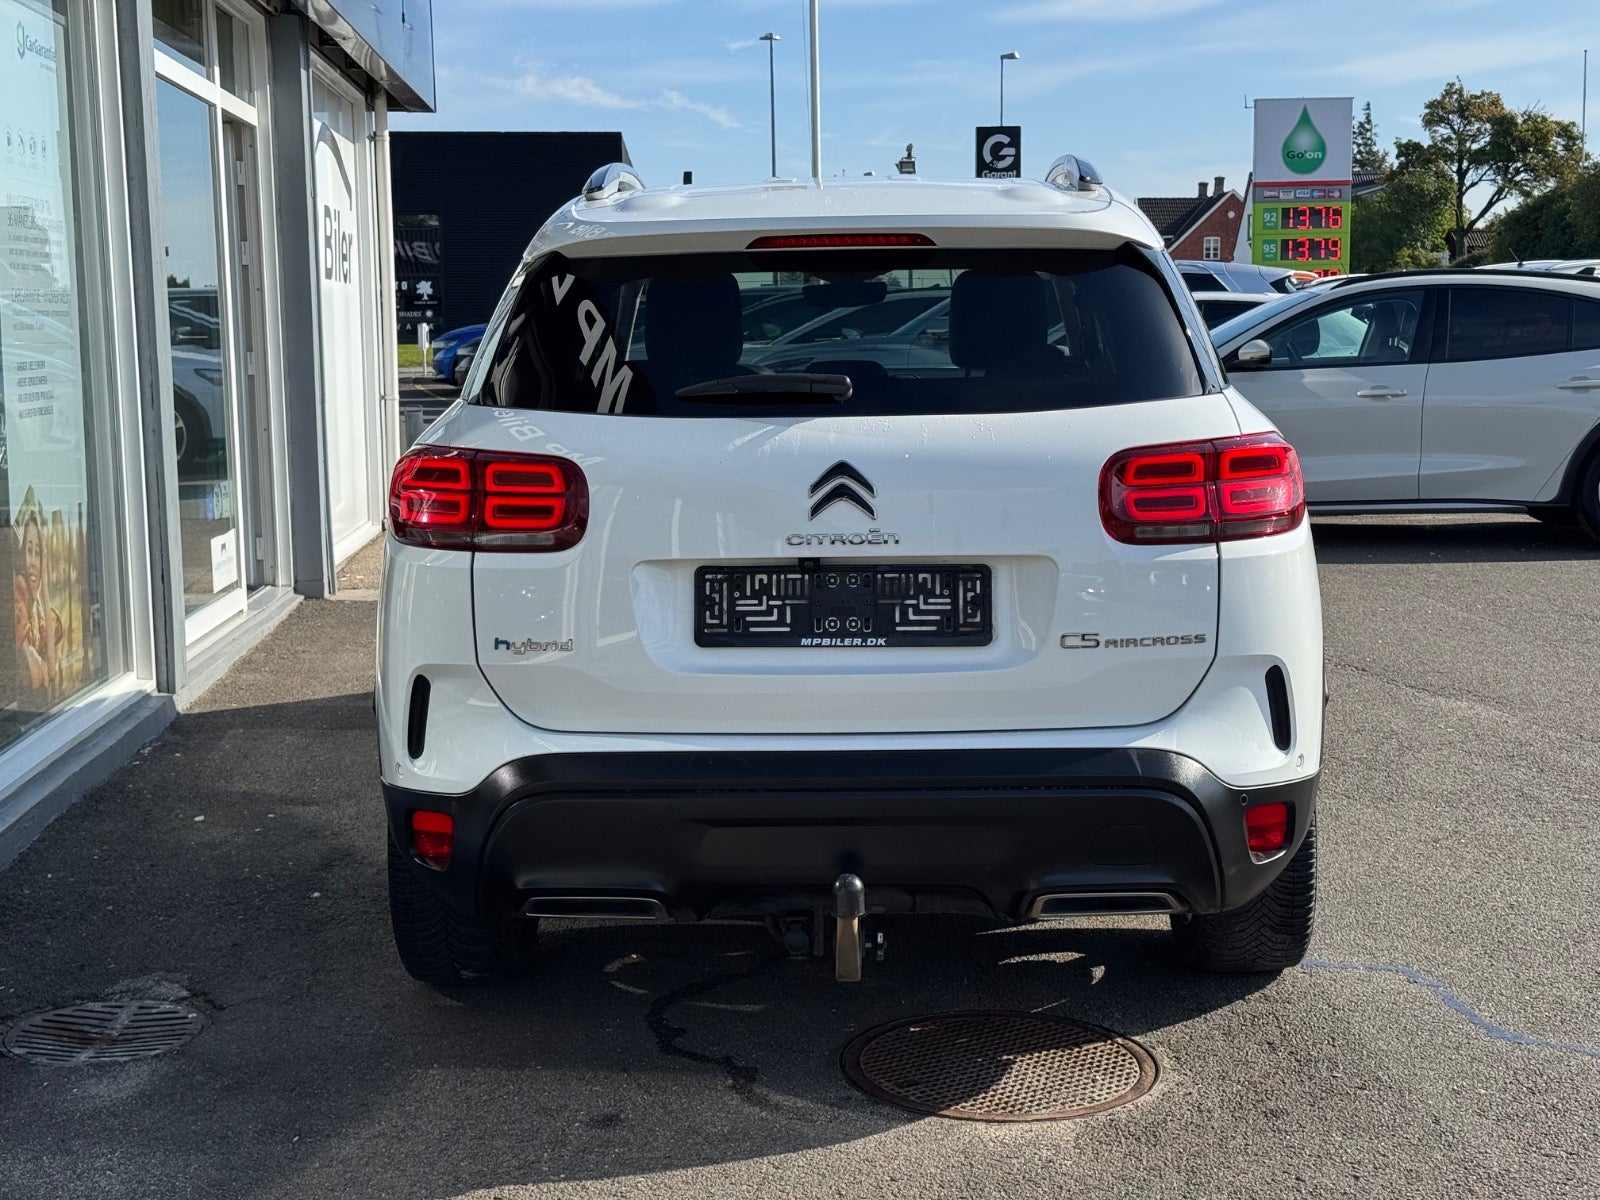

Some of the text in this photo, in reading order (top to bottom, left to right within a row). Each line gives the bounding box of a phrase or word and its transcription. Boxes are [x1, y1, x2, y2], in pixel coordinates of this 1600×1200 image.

[1286, 149, 1322, 160] Go'on
[1263, 205, 1342, 230] 92 13.76
[324, 204, 353, 284] Biler
[1263, 237, 1342, 262] 95 13.79
[786, 528, 900, 547] CITROËN
[494, 636, 573, 655] hybrid
[800, 637, 887, 647] MPBILER.DK
[1060, 632, 1207, 649] C5 AIRCROSS
